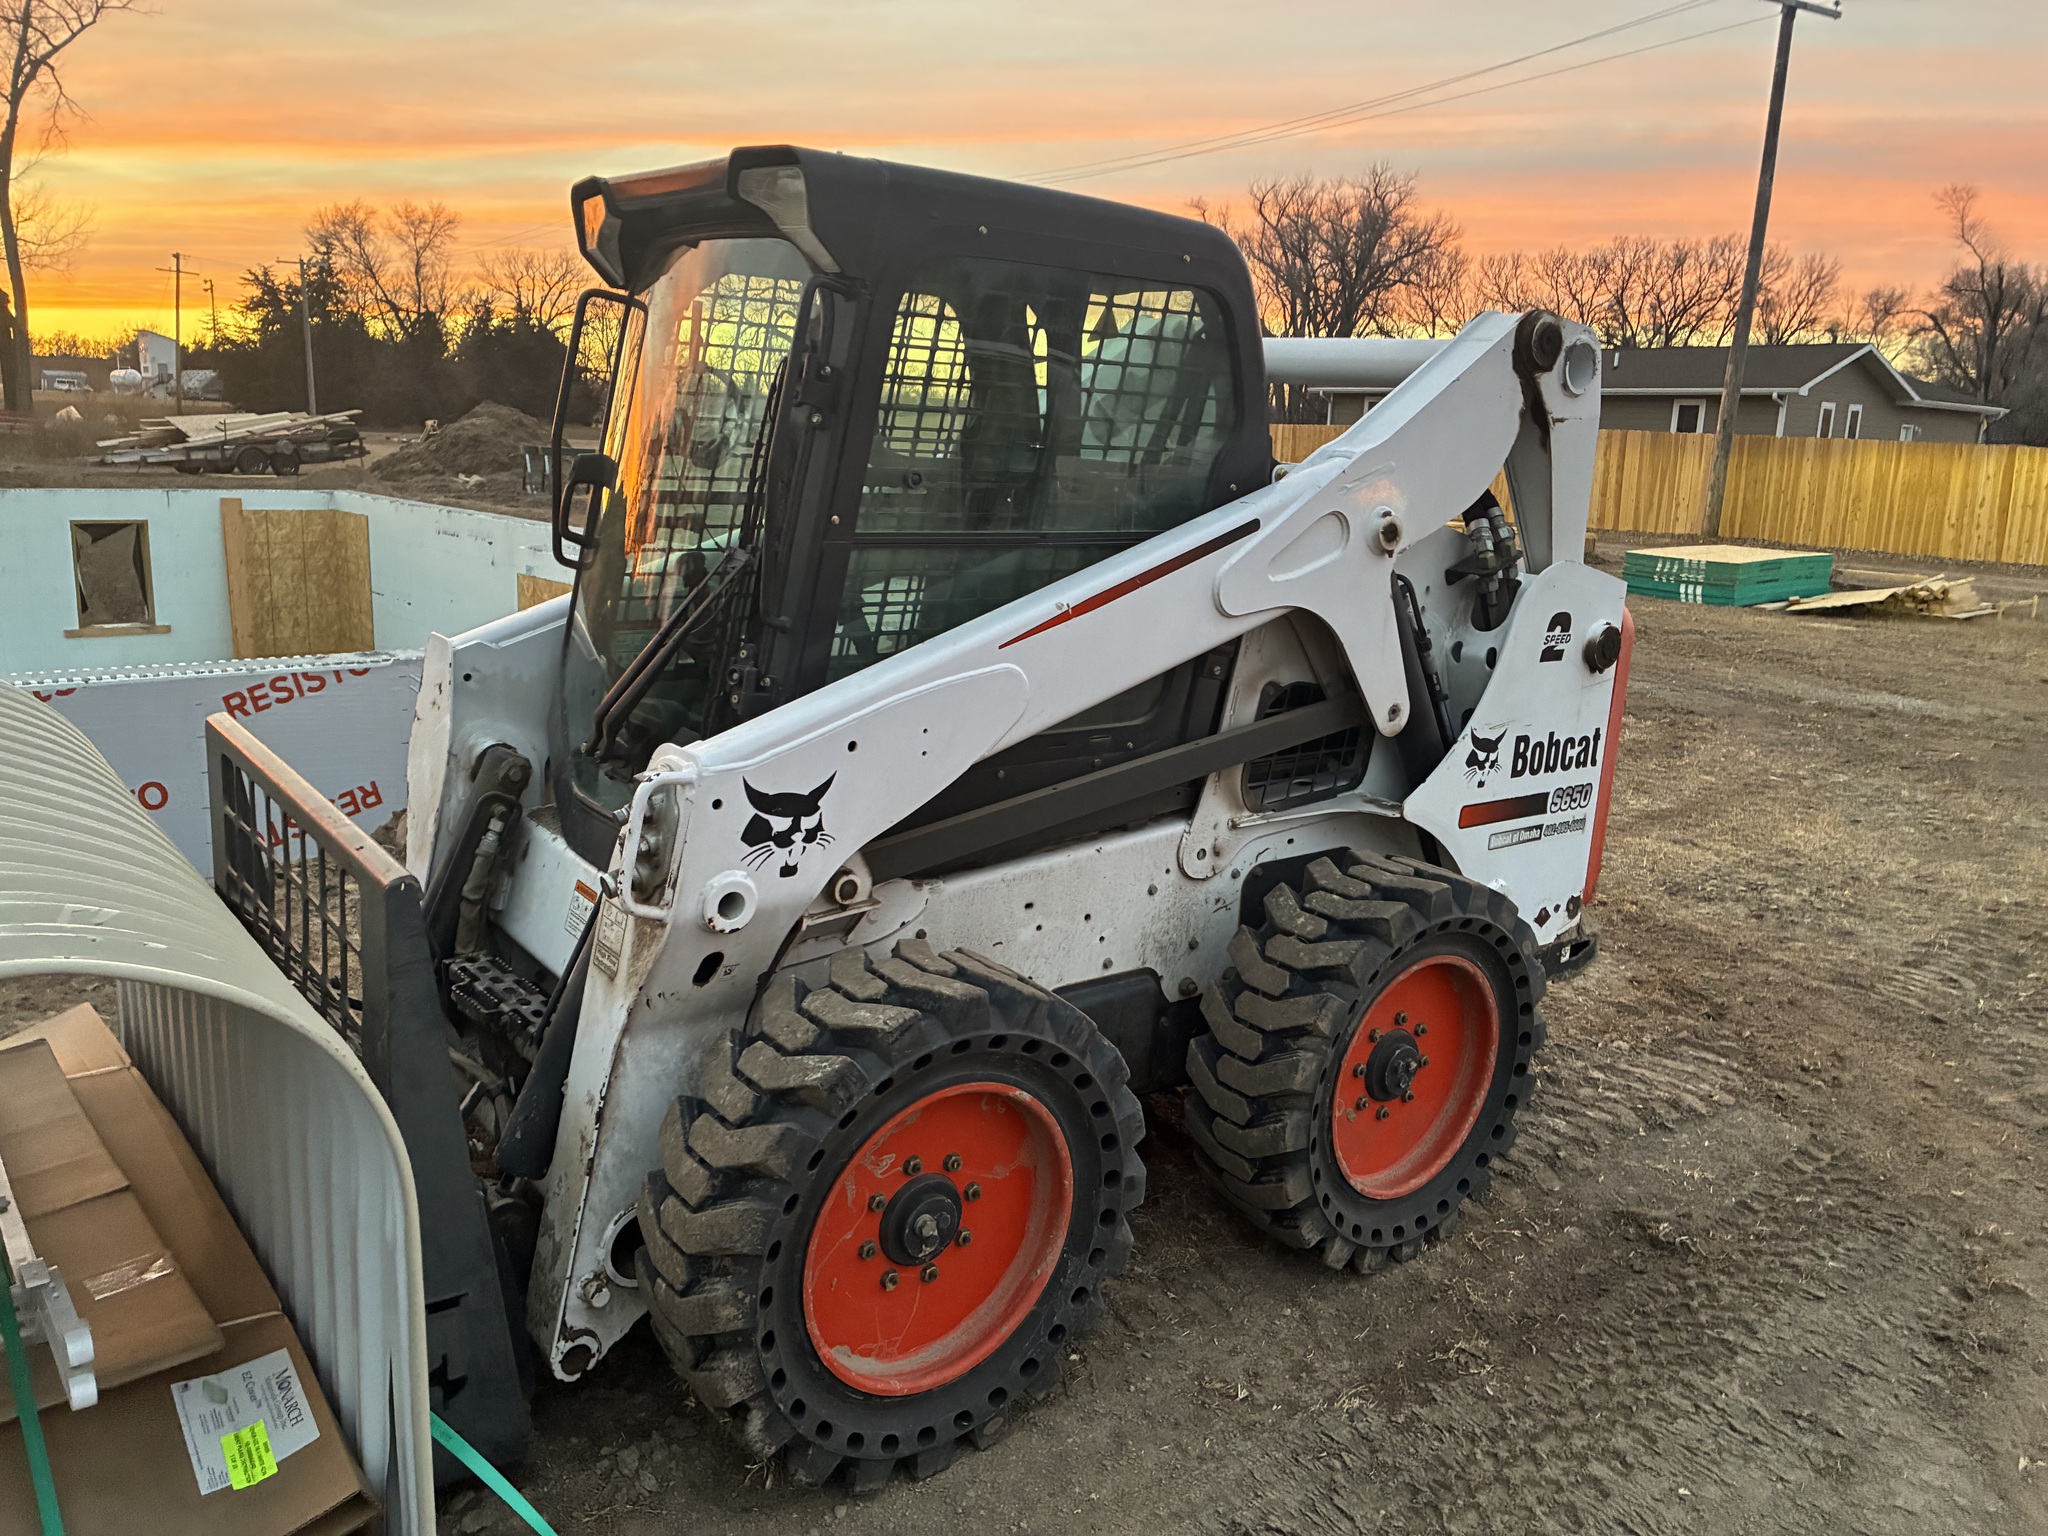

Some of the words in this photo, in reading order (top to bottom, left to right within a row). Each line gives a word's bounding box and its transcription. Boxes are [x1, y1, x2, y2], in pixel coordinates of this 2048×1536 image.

[1539, 611, 1571, 662] 2
[1543, 633, 1571, 645] SPEED
[1510, 727, 1601, 779] Bobcat
[1549, 783, 1593, 814] S650
[1520, 828, 1540, 840] Omaha
[242, 1371, 252, 1382] EZ
[272, 1367, 304, 1427] MONARCH
